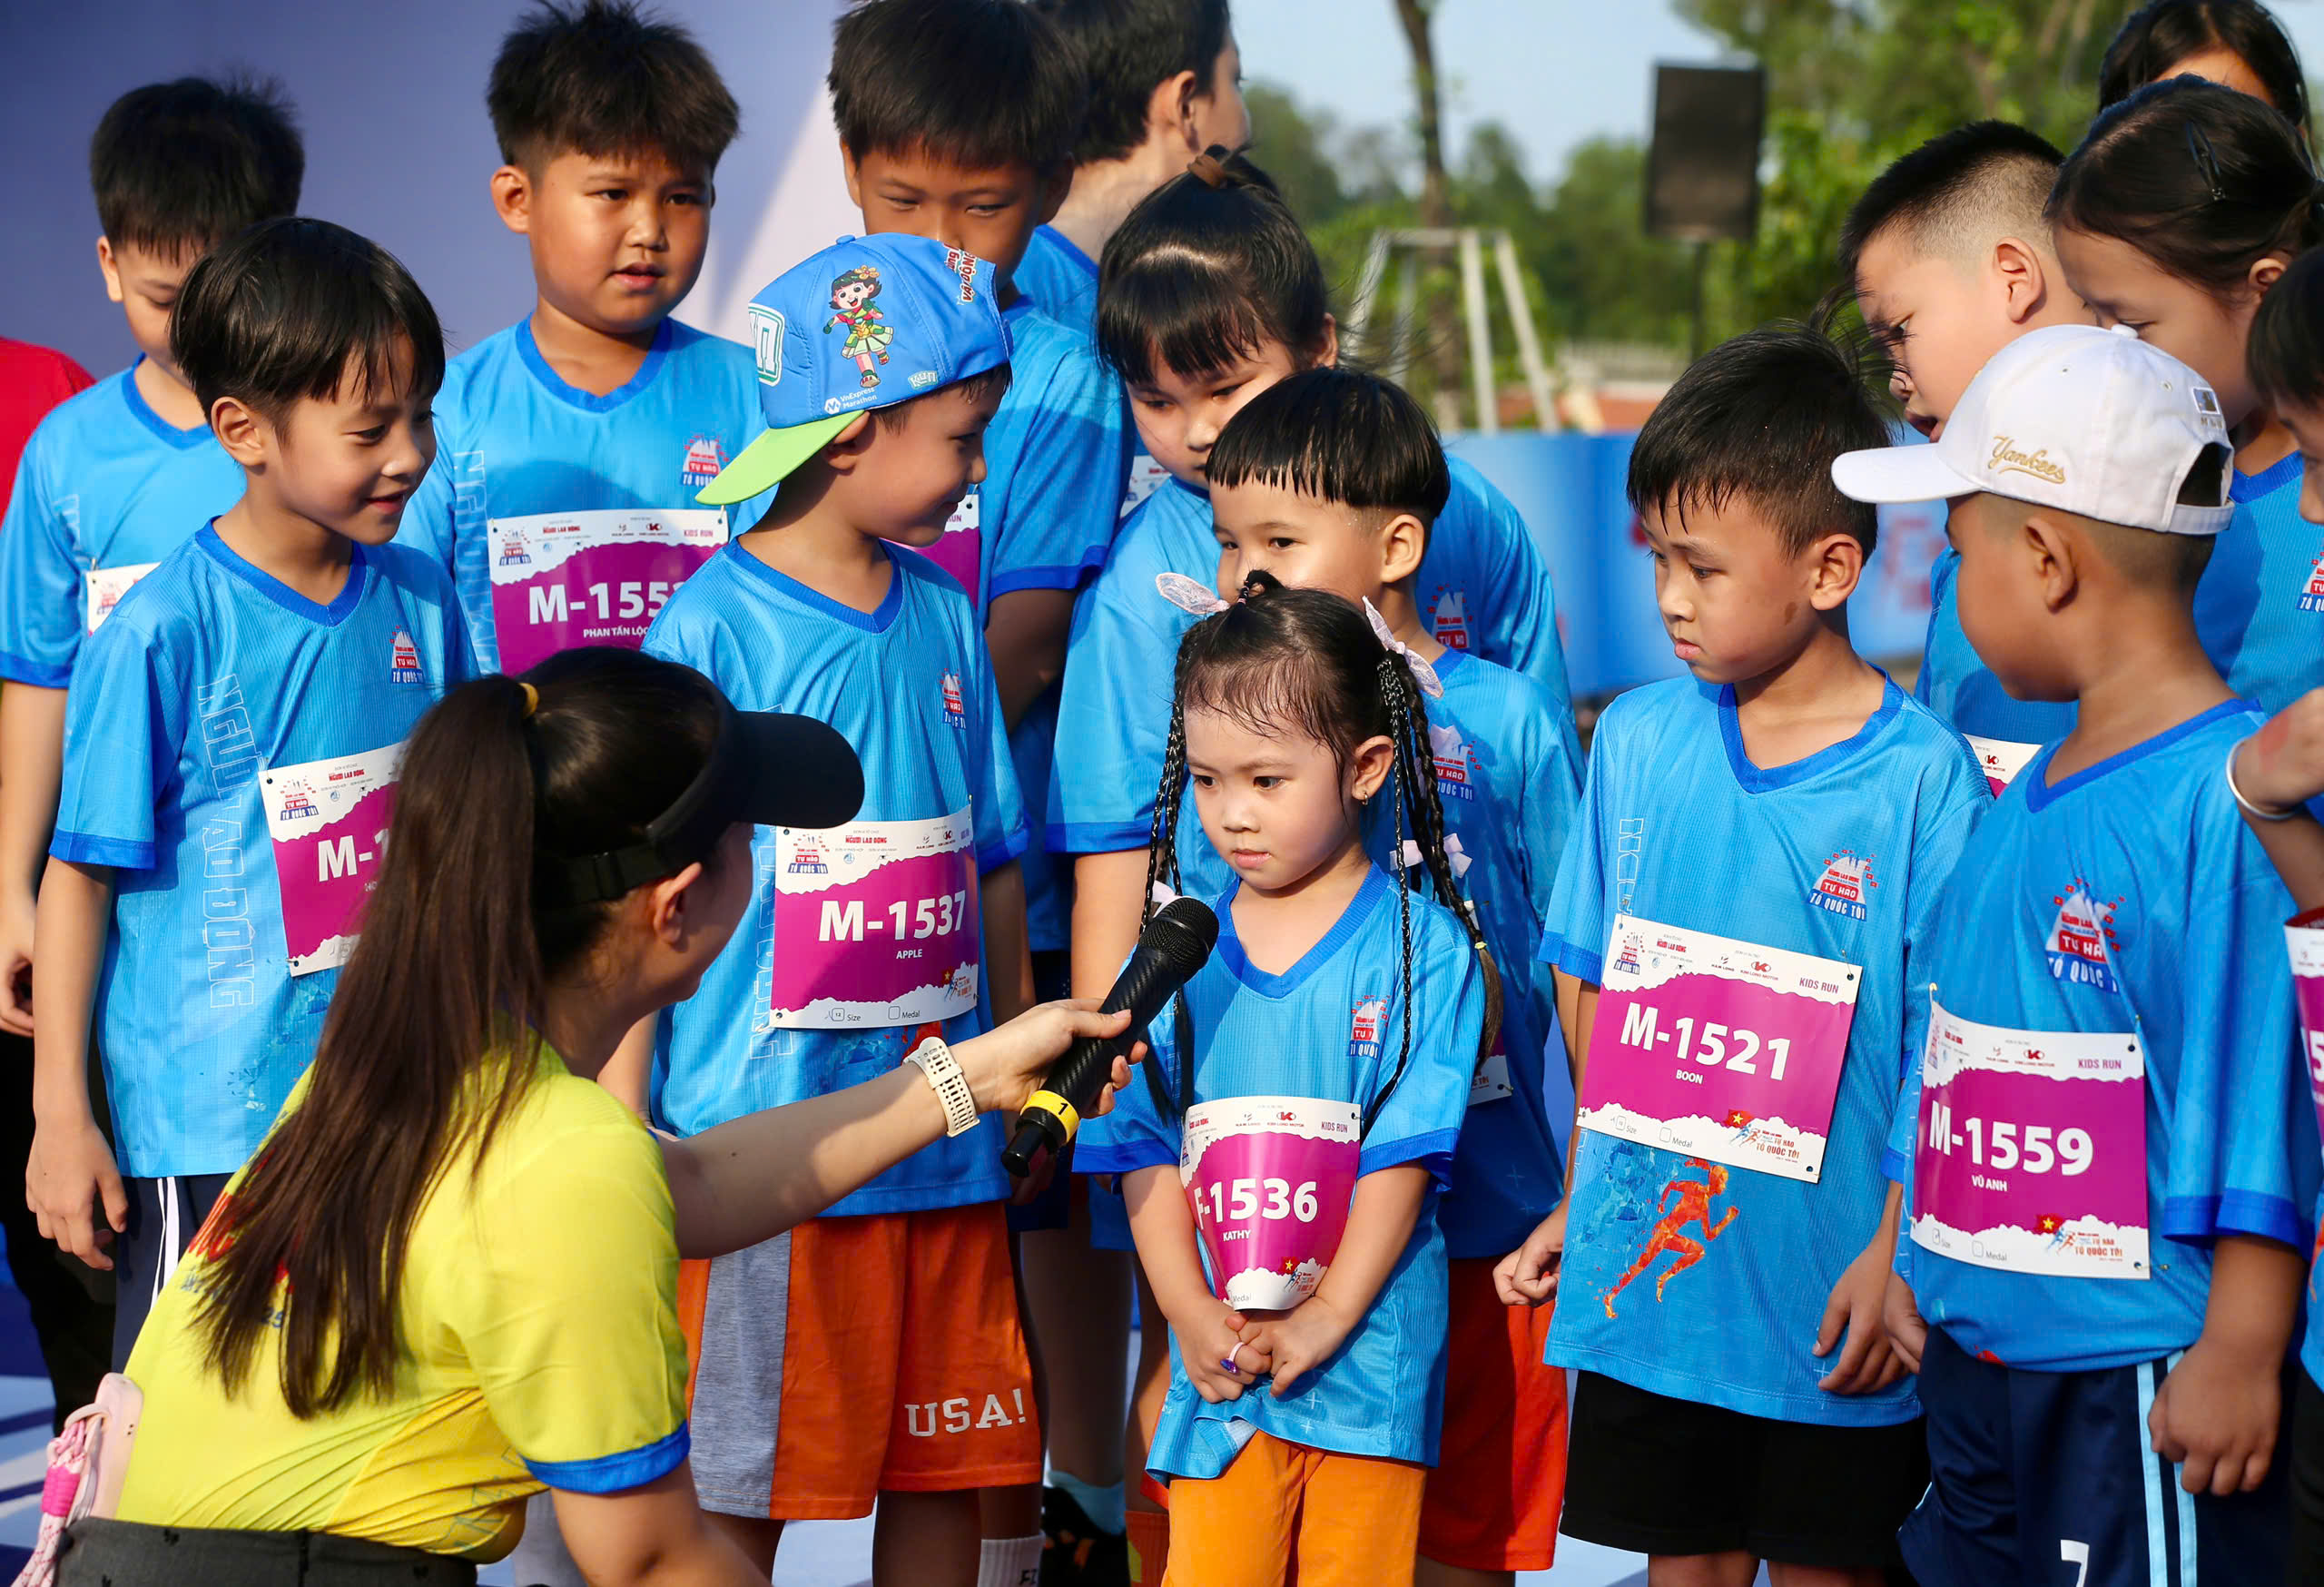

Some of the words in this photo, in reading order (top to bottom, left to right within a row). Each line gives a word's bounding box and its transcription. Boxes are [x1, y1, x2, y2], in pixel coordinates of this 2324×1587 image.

[842, 394, 878, 409] Marathon
[1987, 435, 2065, 484] Yankees
[528, 581, 684, 625] M-155
[583, 628, 611, 638] PHAN
[318, 828, 389, 882] M-1
[819, 890, 966, 941] M-1537
[896, 949, 922, 959] APPLE
[1799, 977, 1818, 990] KIDS
[1820, 981, 1839, 994] RUN
[847, 1013, 861, 1021] Size
[901, 1010, 921, 1019] Medal
[1620, 1001, 1791, 1081] M-1521
[2077, 1059, 2100, 1070] KIDS
[2102, 1059, 2122, 1070] RUN
[1676, 1069, 1703, 1084] BOON
[1058, 1102, 1068, 1116] 1
[1321, 1121, 1335, 1131] KIDS
[1336, 1123, 1348, 1133] RUN
[1626, 1126, 1638, 1135] Size
[1672, 1137, 1693, 1148] Medal
[1929, 1099, 2094, 1177] M-1559
[1985, 1178, 2008, 1192] ANH
[1194, 1178, 1319, 1230] F-1536
[1223, 1229, 1252, 1242] KATHY
[1985, 1250, 2007, 1261] Medal
[904, 1388, 1026, 1437] USA!
[2061, 1539, 2090, 1587] 7
